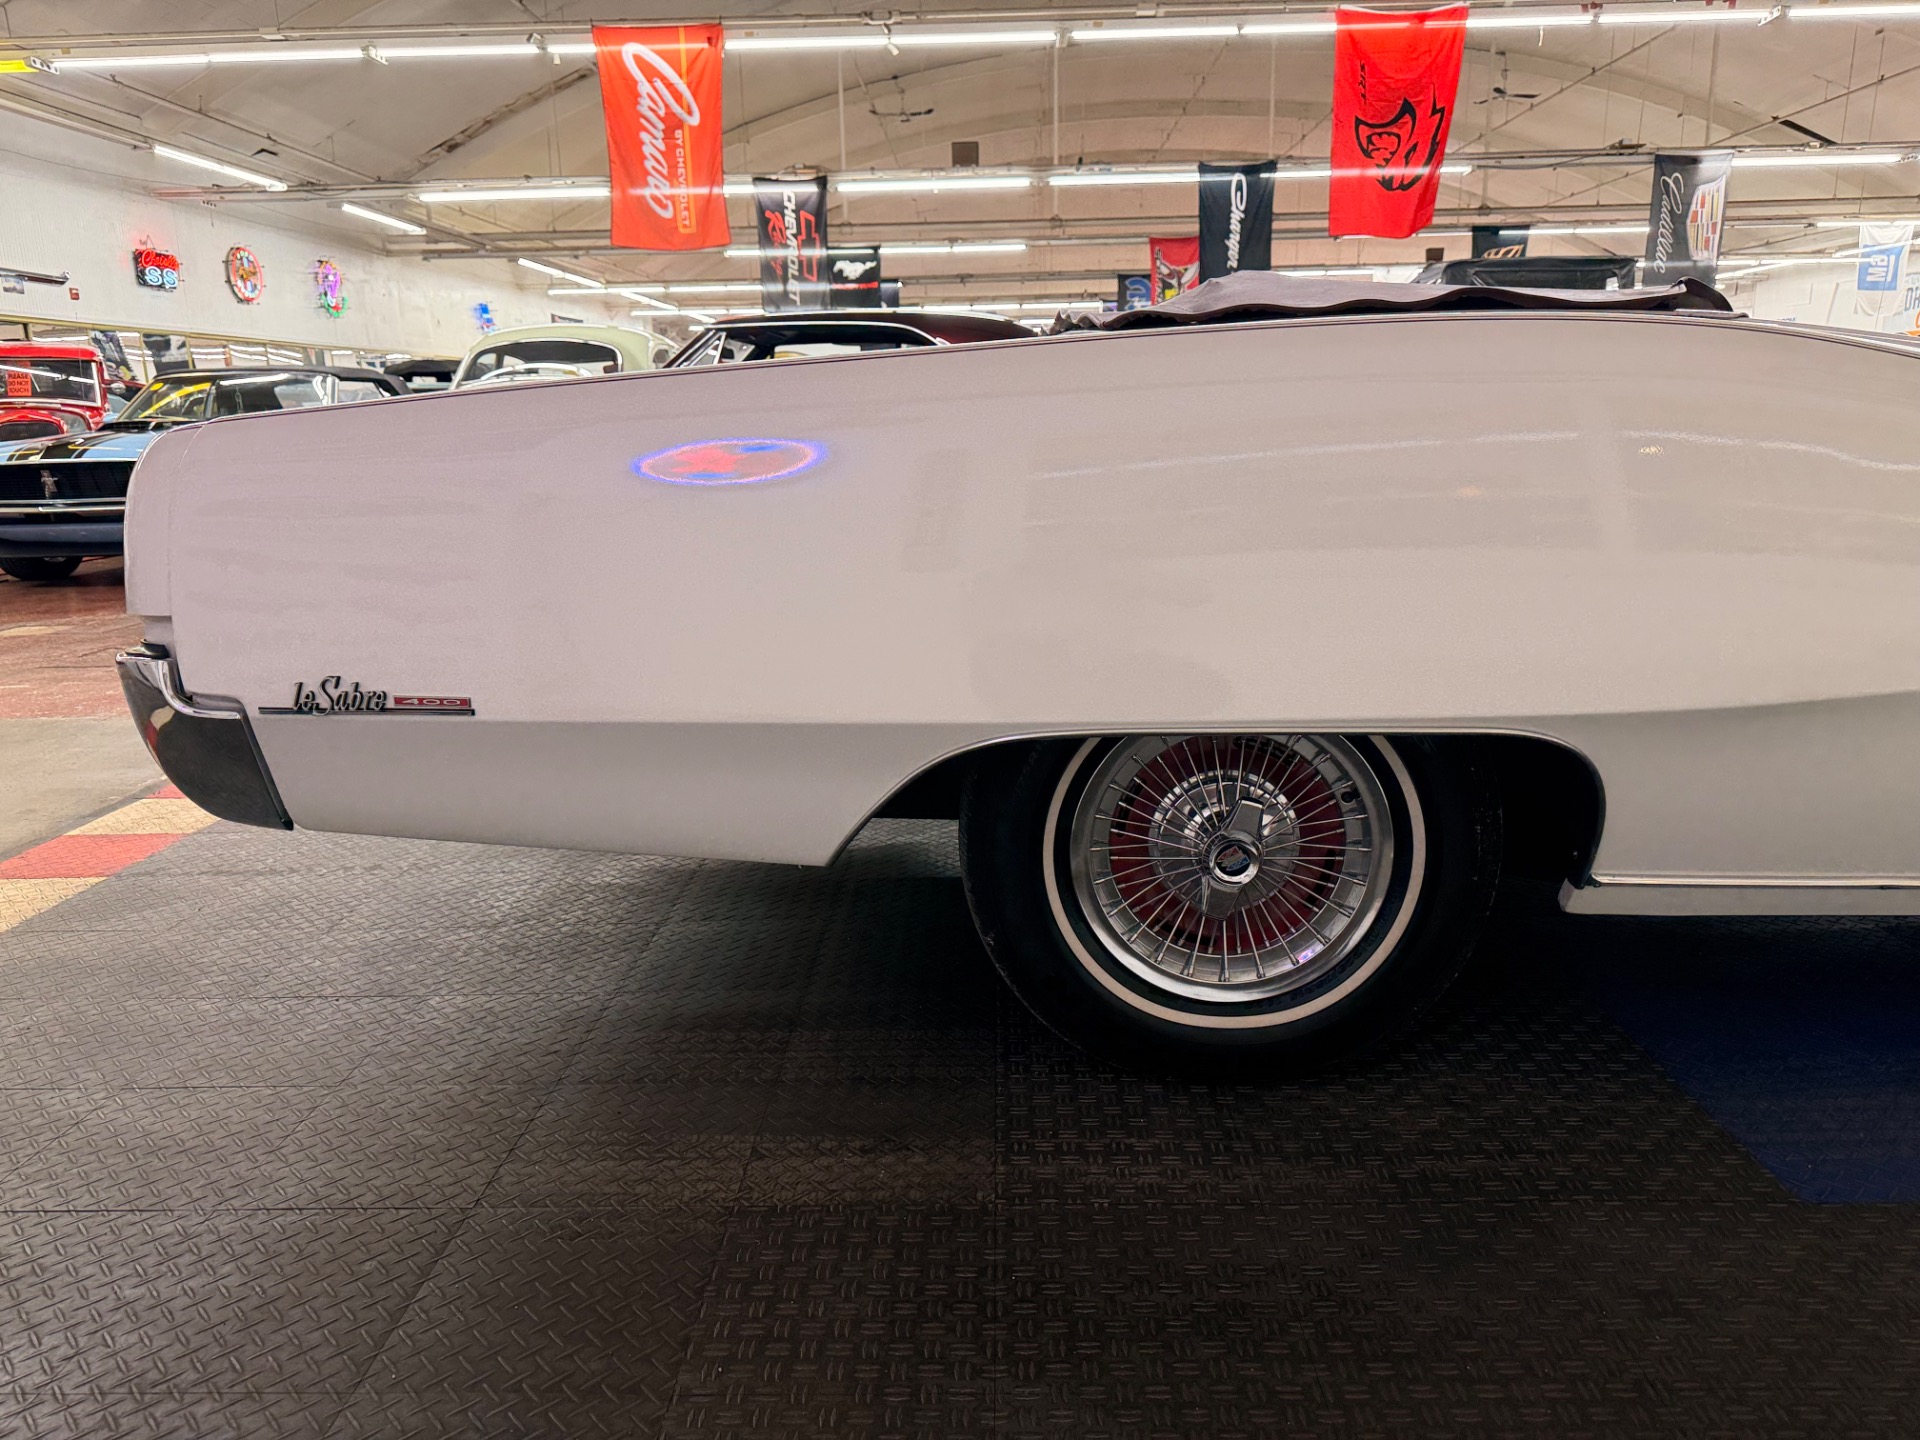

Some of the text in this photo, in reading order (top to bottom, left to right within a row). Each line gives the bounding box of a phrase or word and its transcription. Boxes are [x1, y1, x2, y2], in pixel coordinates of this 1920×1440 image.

[621, 42, 701, 219] Camaro
[674, 129, 690, 228] BY CHEVROLET
[782, 191, 801, 306] CHEVROLET
[1223, 172, 1248, 270] Charger
[1653, 172, 1684, 275] Cadillac
[145, 266, 179, 289] SS
[8, 372, 29, 380] PLEASE
[9, 386, 30, 394] TOUCH
[401, 698, 461, 706] 400
